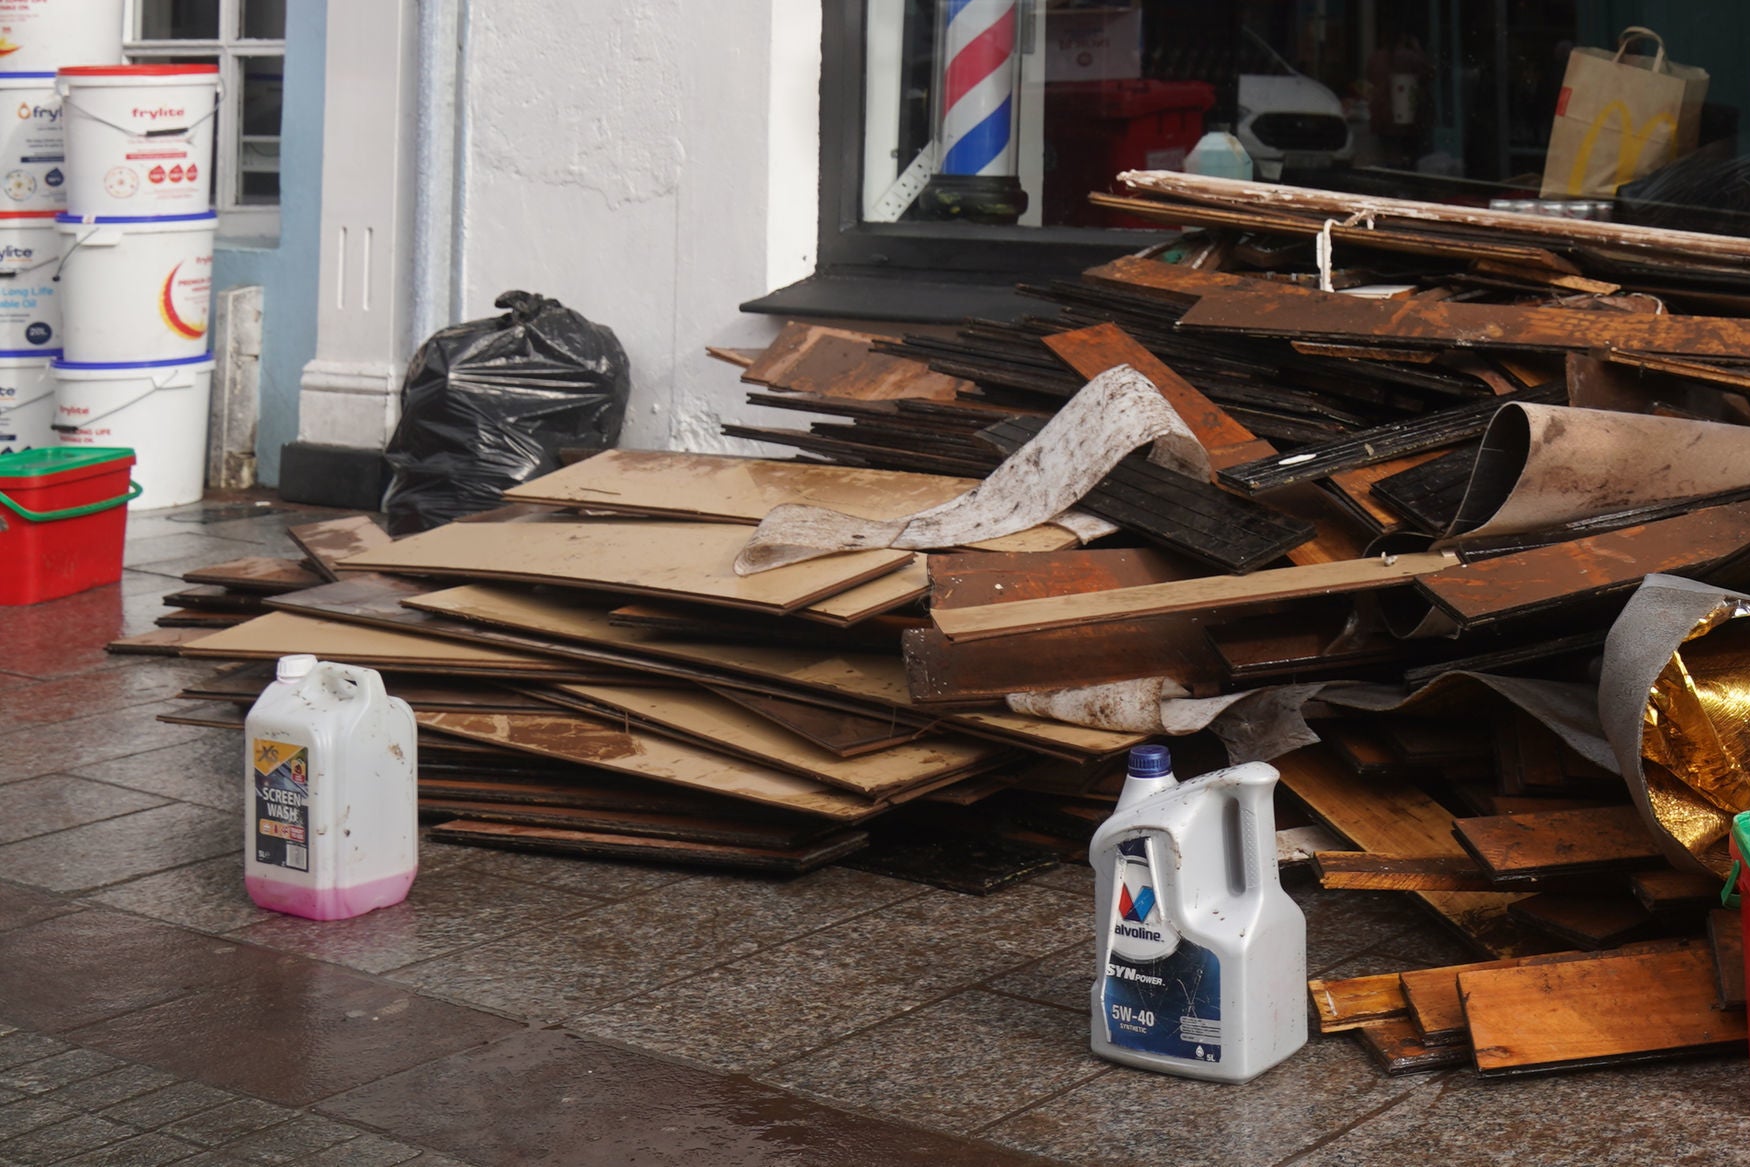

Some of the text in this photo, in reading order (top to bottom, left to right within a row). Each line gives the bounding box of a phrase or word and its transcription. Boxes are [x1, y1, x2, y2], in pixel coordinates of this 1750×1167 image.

[132, 108, 184, 120] frylite
[262, 787, 302, 807] SCREEN
[266, 802, 300, 823] WASH
[1111, 1004, 1155, 1027] 5W-40
[1119, 1022, 1148, 1034] SYNTHETIC
